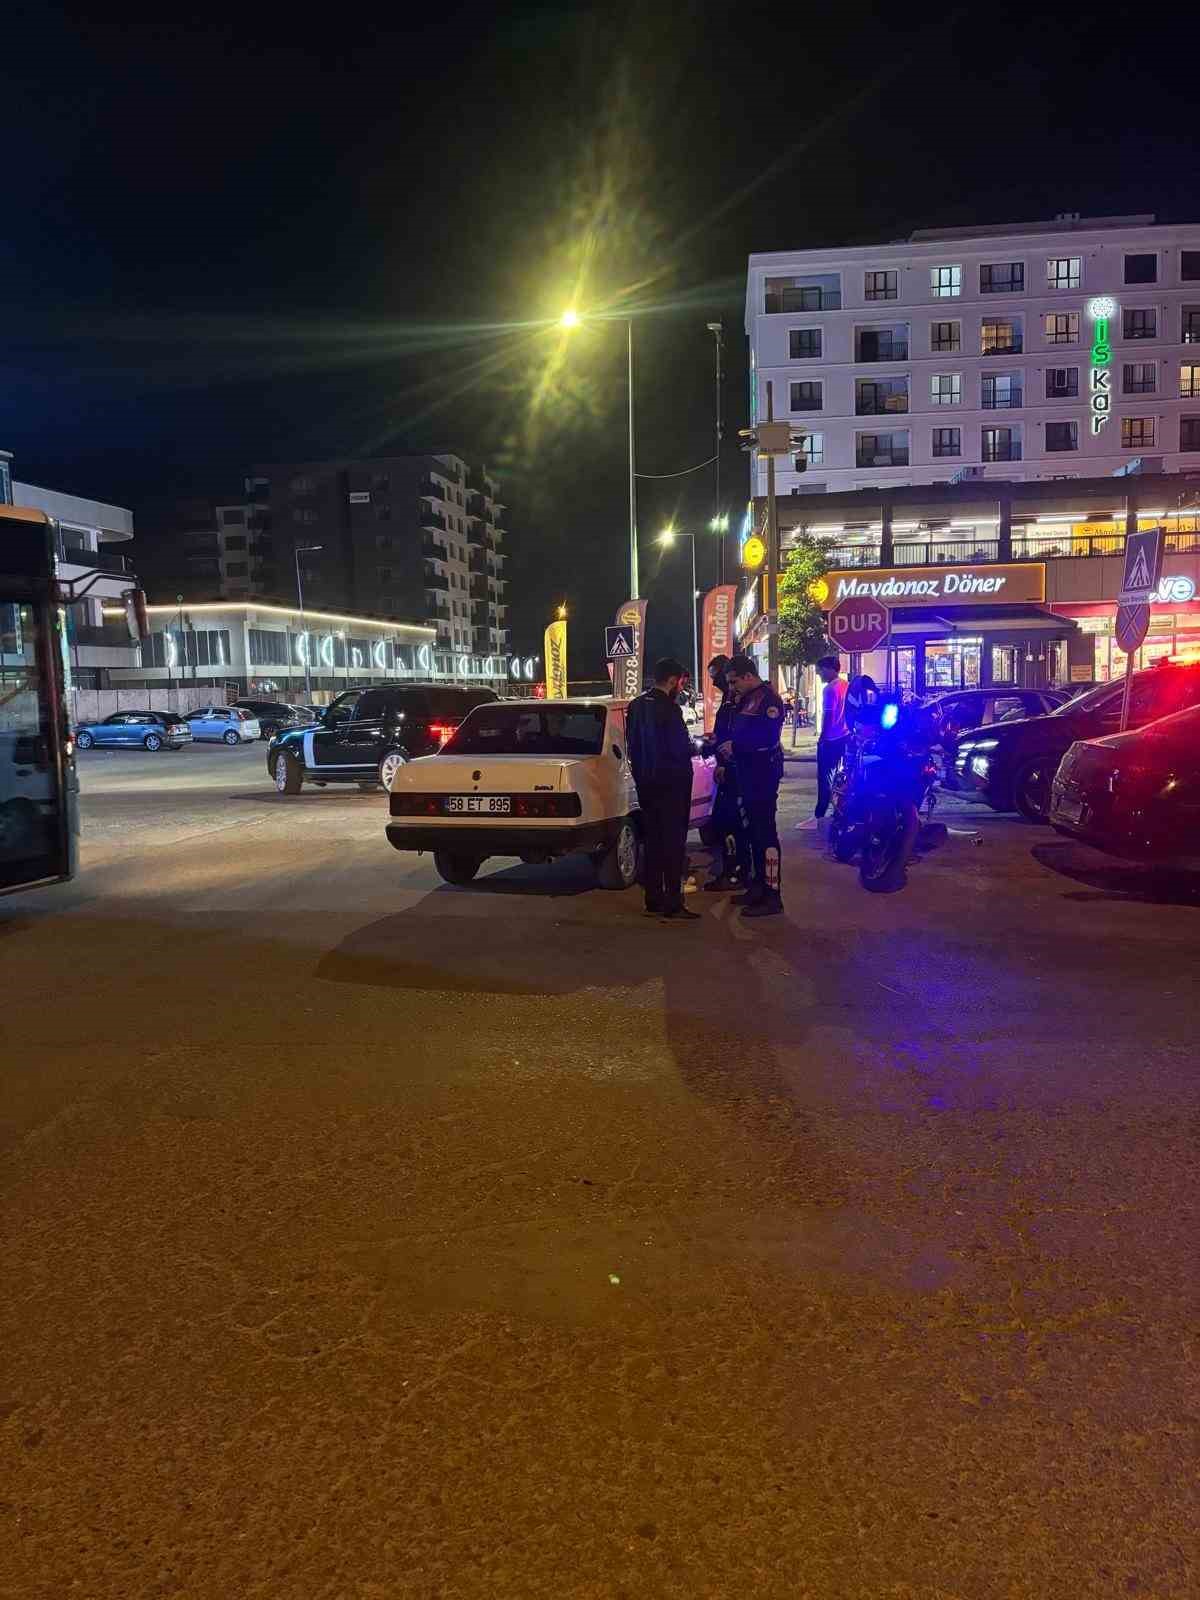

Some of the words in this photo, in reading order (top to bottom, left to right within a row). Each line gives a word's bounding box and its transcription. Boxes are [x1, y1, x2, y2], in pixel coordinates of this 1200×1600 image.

[943, 573, 1007, 594] Döner
[711, 593, 729, 648] Chicken
[834, 612, 882, 635] DUR
[450, 797, 464, 812] 58
[467, 798, 483, 812] ET
[488, 798, 510, 813] 895
